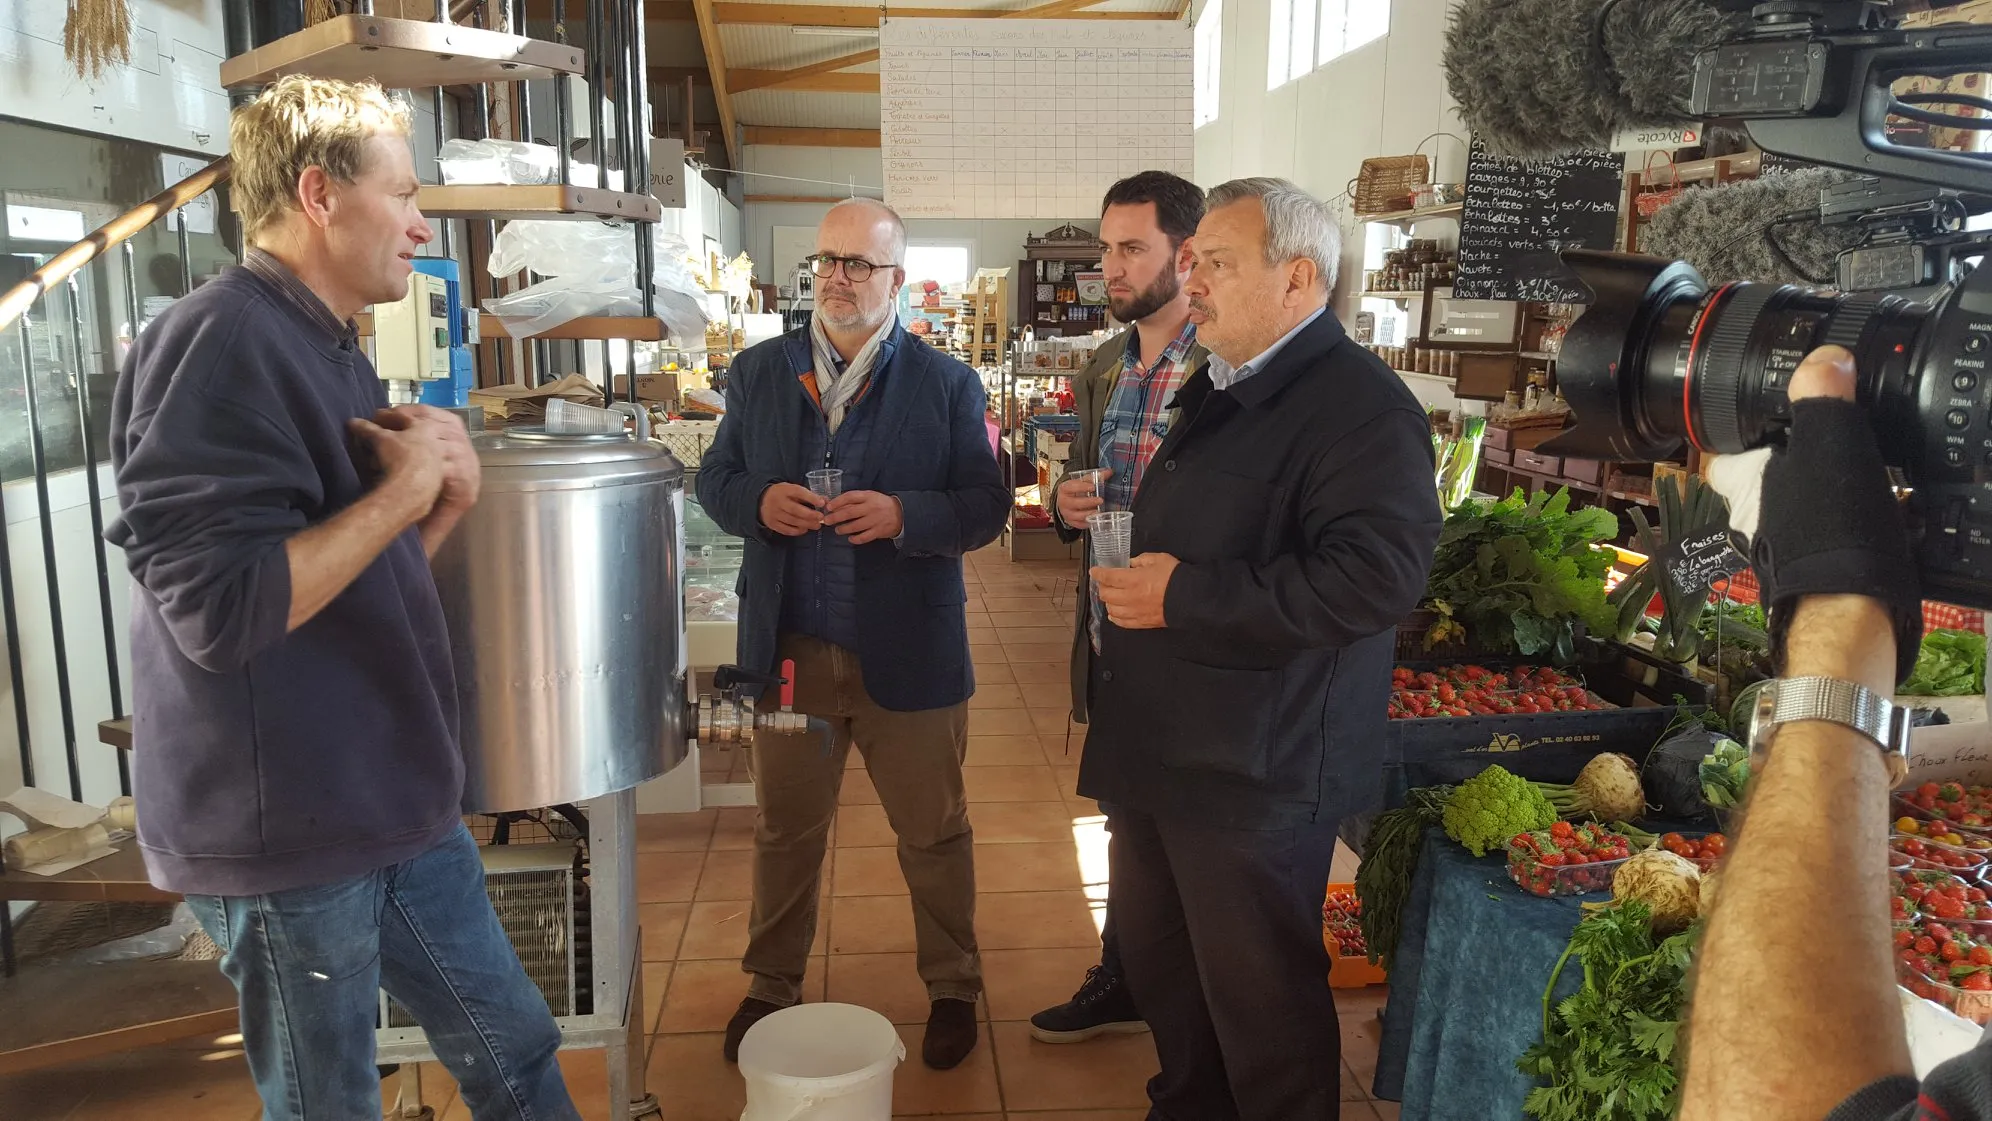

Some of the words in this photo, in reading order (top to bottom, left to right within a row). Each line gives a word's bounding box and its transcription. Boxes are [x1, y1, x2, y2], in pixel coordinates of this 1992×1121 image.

[1637, 128, 1682, 146] Rycote
[1506, 163, 1519, 172] de
[1460, 249, 1490, 261] Mache
[1458, 263, 1492, 274] Navets
[1972, 339, 1979, 348] 8
[1953, 358, 1985, 368] PEAKING
[1962, 376, 1969, 386] 9
[1950, 398, 1972, 407] ZEBRA
[1953, 415, 1963, 424] 10
[1949, 452, 1958, 461] 11
[1680, 531, 1725, 556] Fraises
